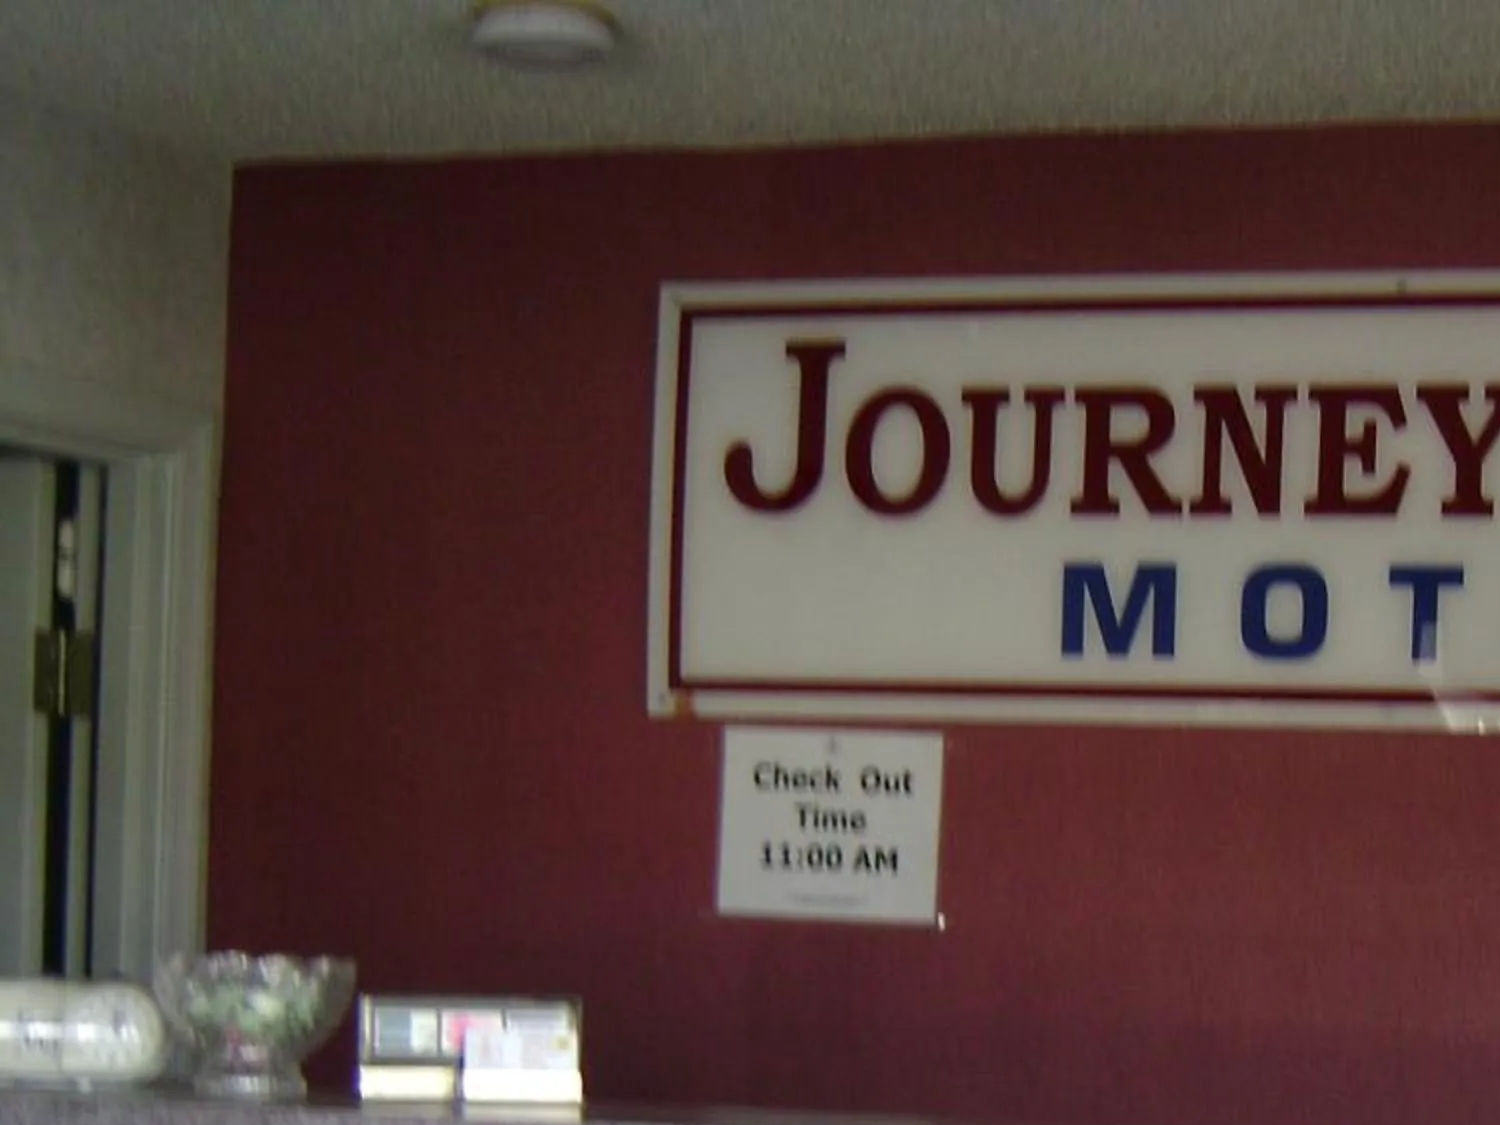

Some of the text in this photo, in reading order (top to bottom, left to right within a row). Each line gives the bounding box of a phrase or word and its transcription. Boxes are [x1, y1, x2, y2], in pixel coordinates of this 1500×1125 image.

[753, 761, 914, 796] Check Out
[794, 802, 868, 833] Time
[761, 842, 899, 876] 11:00 AM
